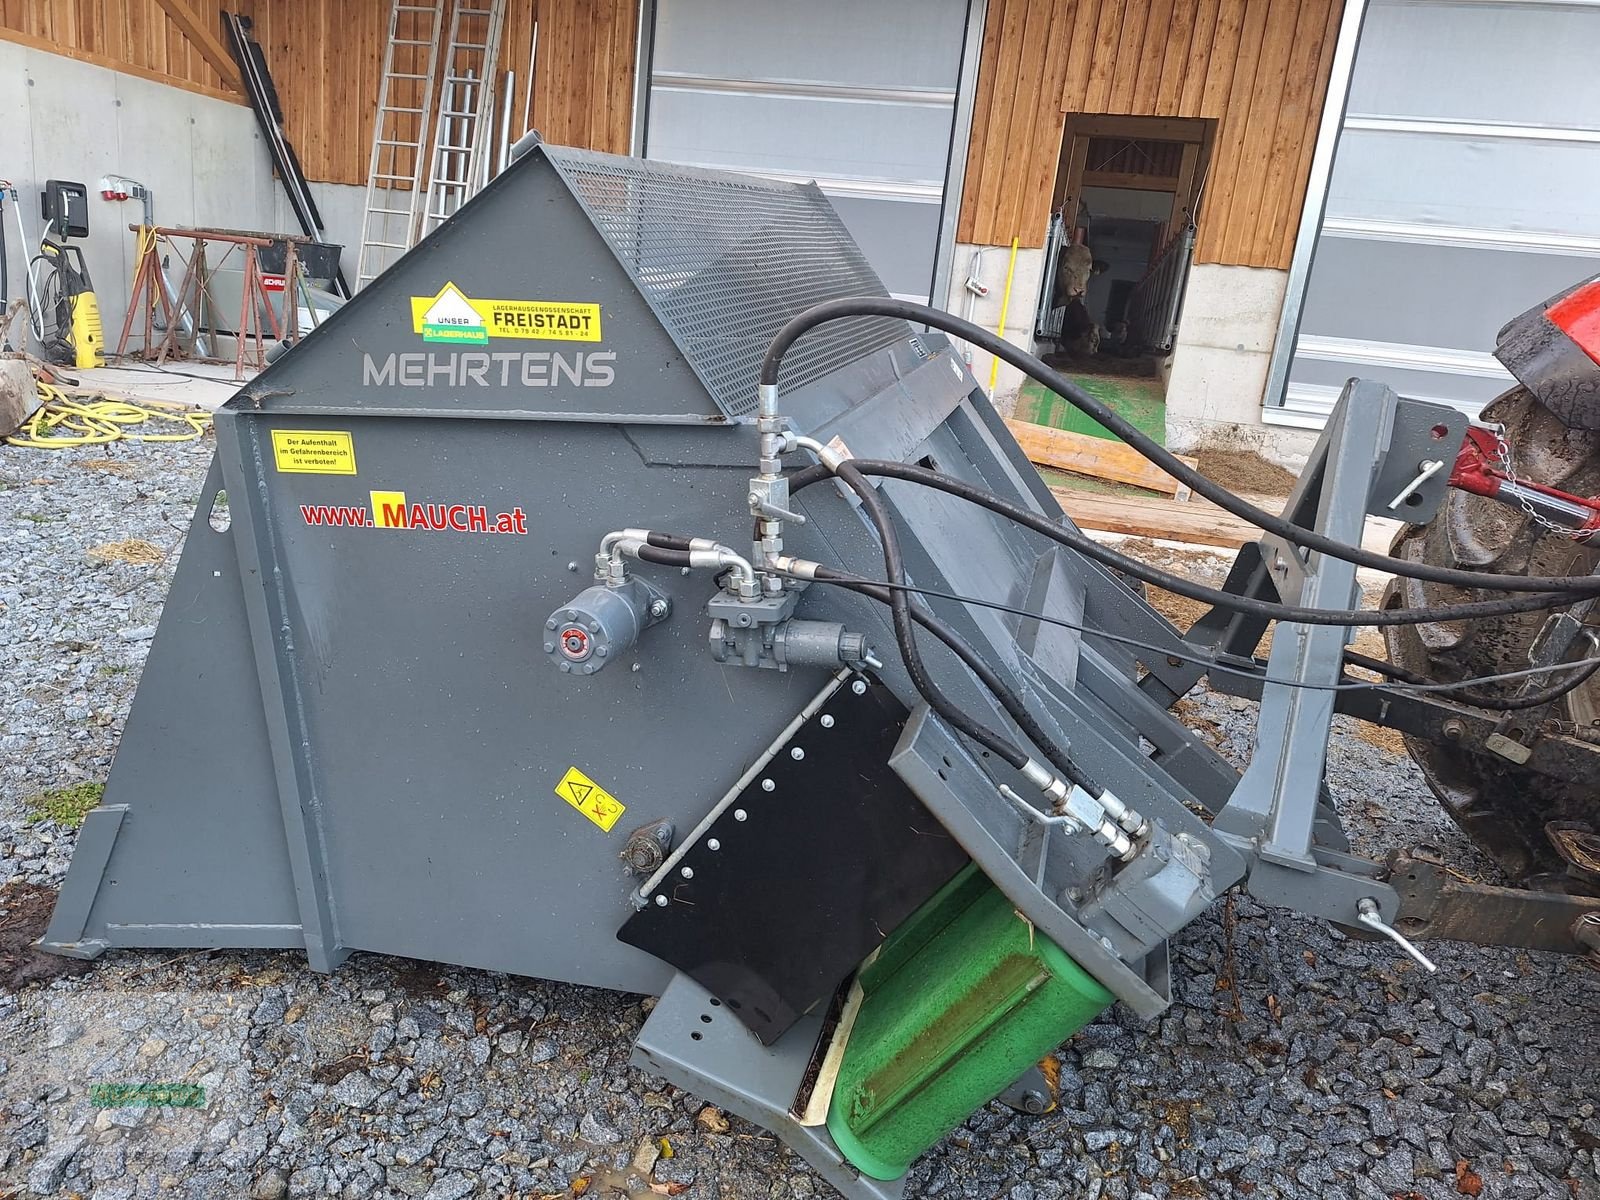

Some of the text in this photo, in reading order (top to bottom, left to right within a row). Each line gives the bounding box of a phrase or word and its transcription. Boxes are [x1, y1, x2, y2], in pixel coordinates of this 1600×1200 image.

[492, 305, 592, 314] LAGERHAUSGENOSSENSCHAFT
[437, 317, 470, 325] UNSER
[493, 312, 592, 329] FREISTADT
[432, 329, 485, 340] LAGERHAUS
[363, 352, 617, 387] MEHRTENS
[290, 448, 348, 456] Gefahrenbereich
